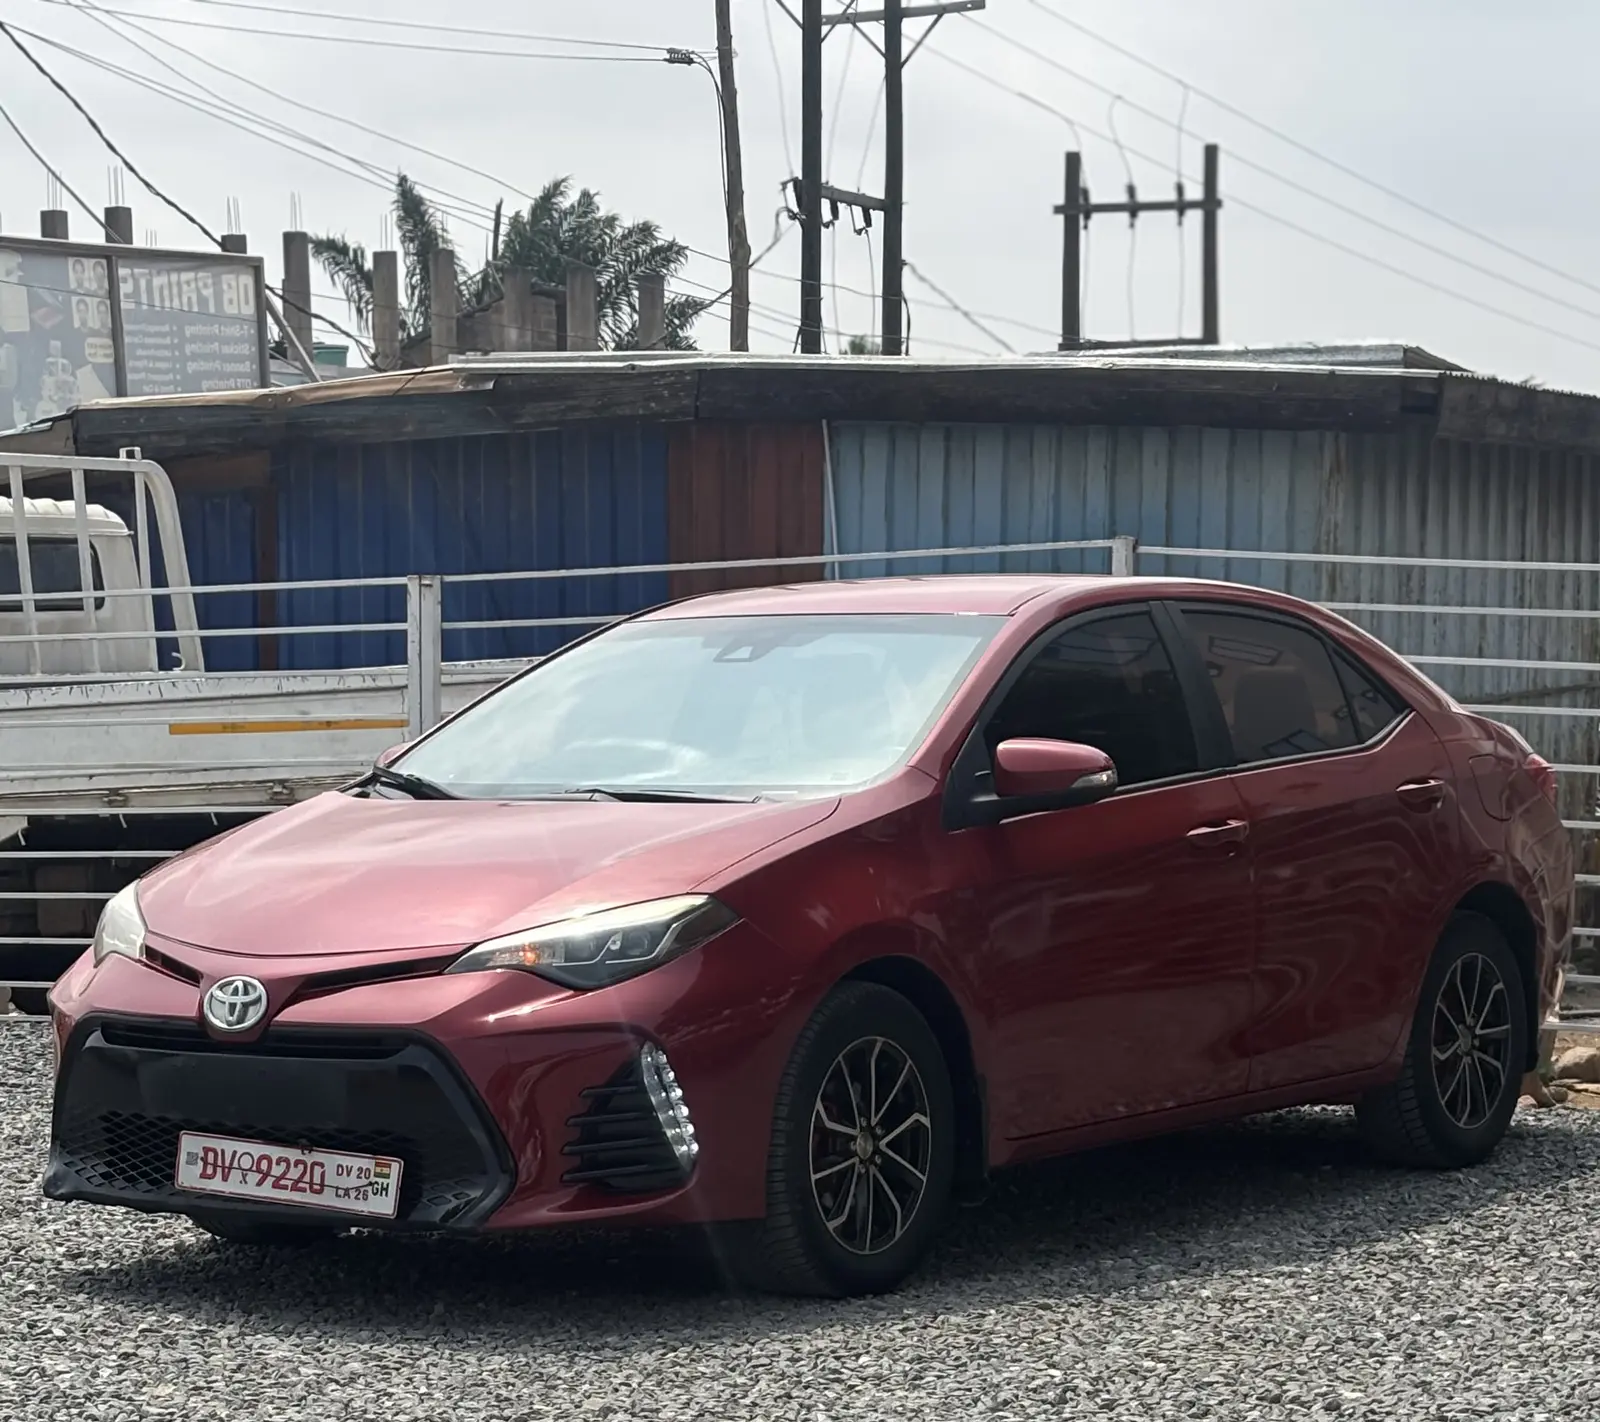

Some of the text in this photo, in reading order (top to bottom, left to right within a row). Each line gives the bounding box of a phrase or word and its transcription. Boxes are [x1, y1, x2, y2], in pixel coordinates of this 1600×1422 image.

[199, 1145, 326, 1195] DV 9220
[336, 1163, 372, 1180] DV 20
[335, 1185, 369, 1202] LA 26
[371, 1180, 390, 1198] GH
